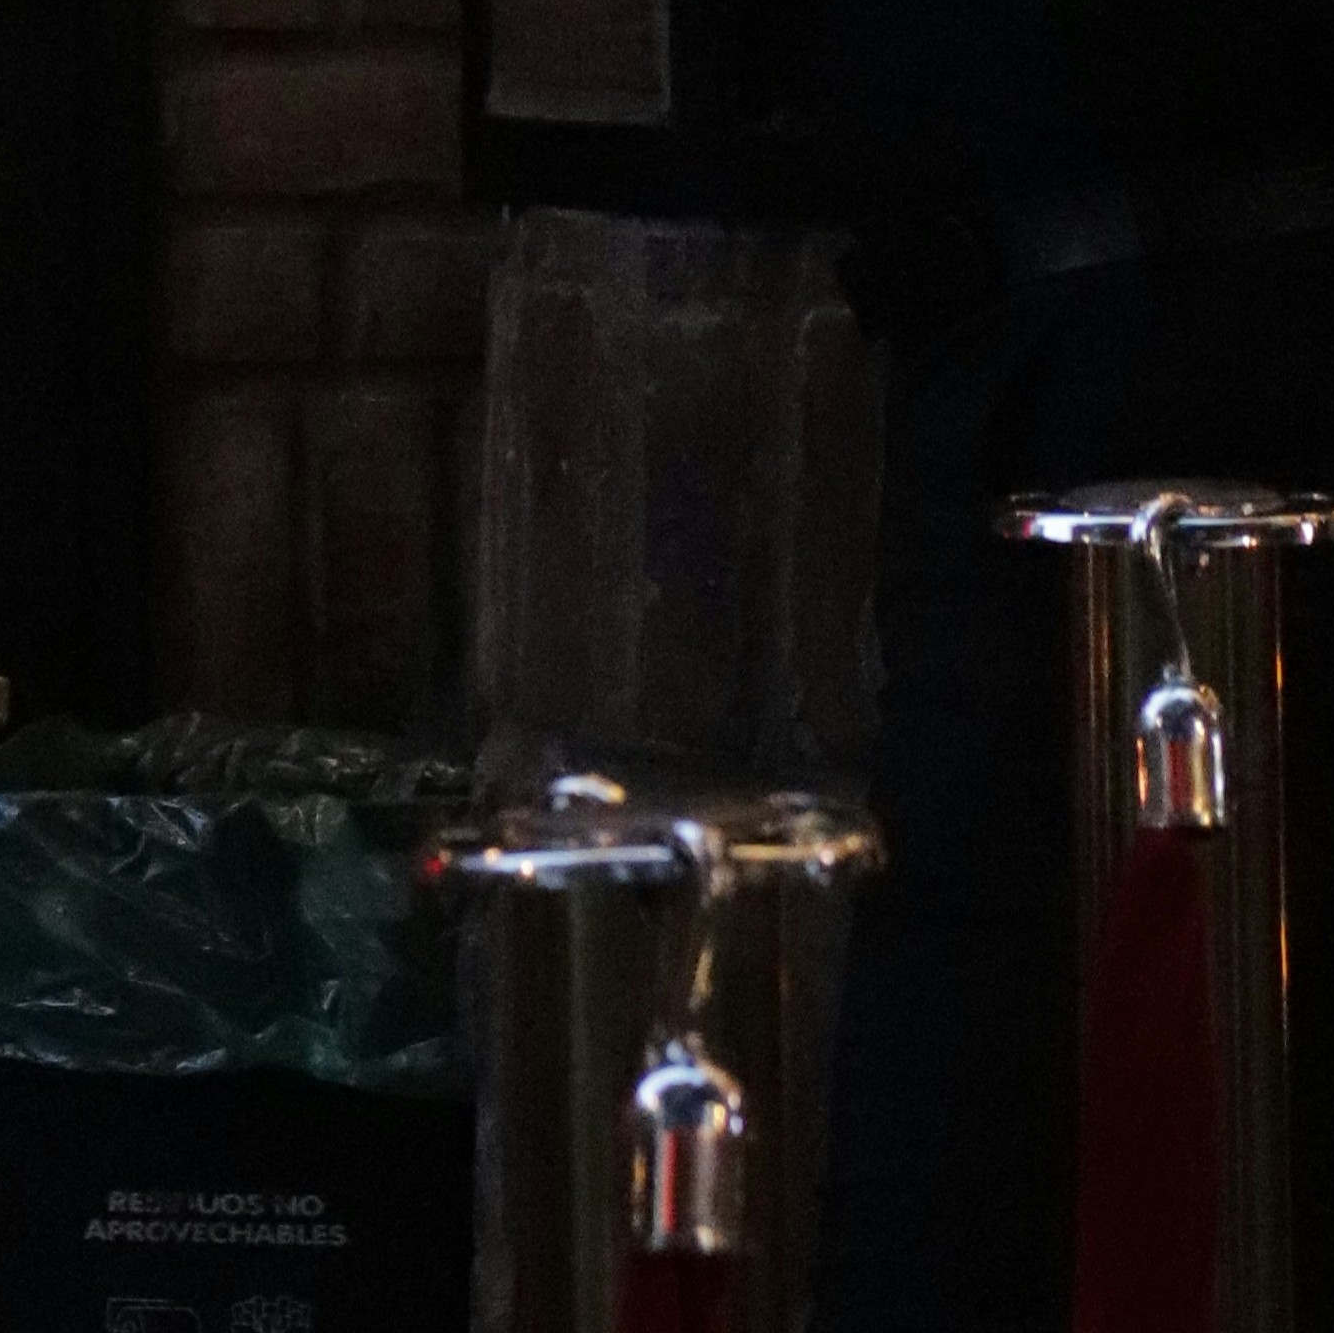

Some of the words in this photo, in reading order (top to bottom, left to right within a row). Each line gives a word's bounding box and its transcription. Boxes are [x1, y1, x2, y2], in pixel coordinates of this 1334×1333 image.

[105, 1190, 265, 1216] RESUOS
[273, 1193, 325, 1217] NO
[83, 1218, 348, 1246] APROVECHABLES
